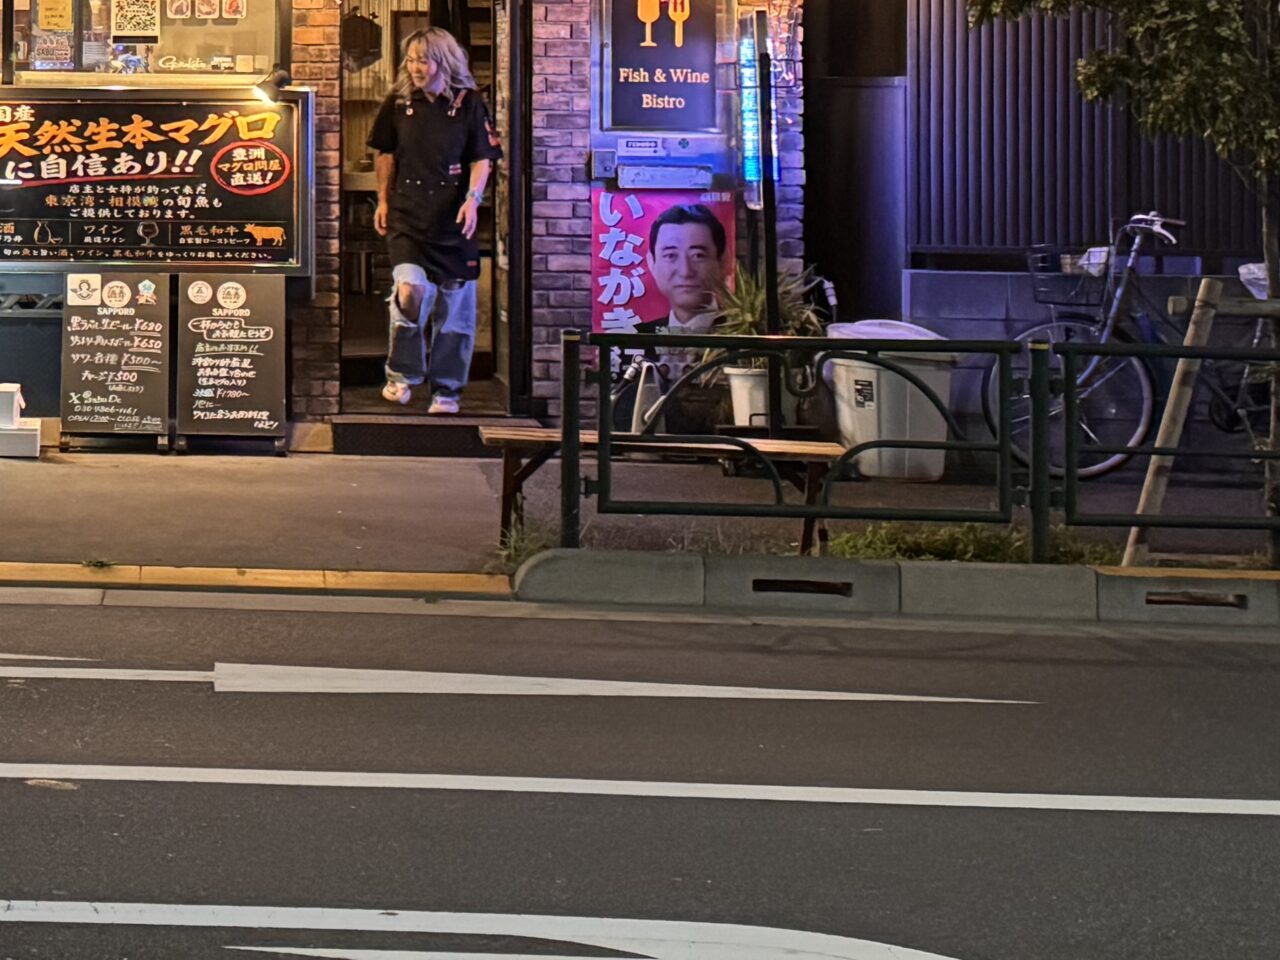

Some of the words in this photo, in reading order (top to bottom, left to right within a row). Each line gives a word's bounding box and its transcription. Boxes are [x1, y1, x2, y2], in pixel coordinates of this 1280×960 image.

[619, 67, 650, 84] Fish
[653, 67, 667, 84] &
[669, 67, 710, 84] Wine
[641, 93, 685, 109] Bistro
[232, 147, 266, 162] 豊洲
[217, 159, 282, 173] マグロ問屋
[69, 208, 196, 219] ご提供しております。
[83, 224, 124, 235] ワイン
[179, 225, 240, 237] 黒毛和牛
[96, 307, 136, 315] SAPPORO
[212, 308, 251, 316] SAPPORO
